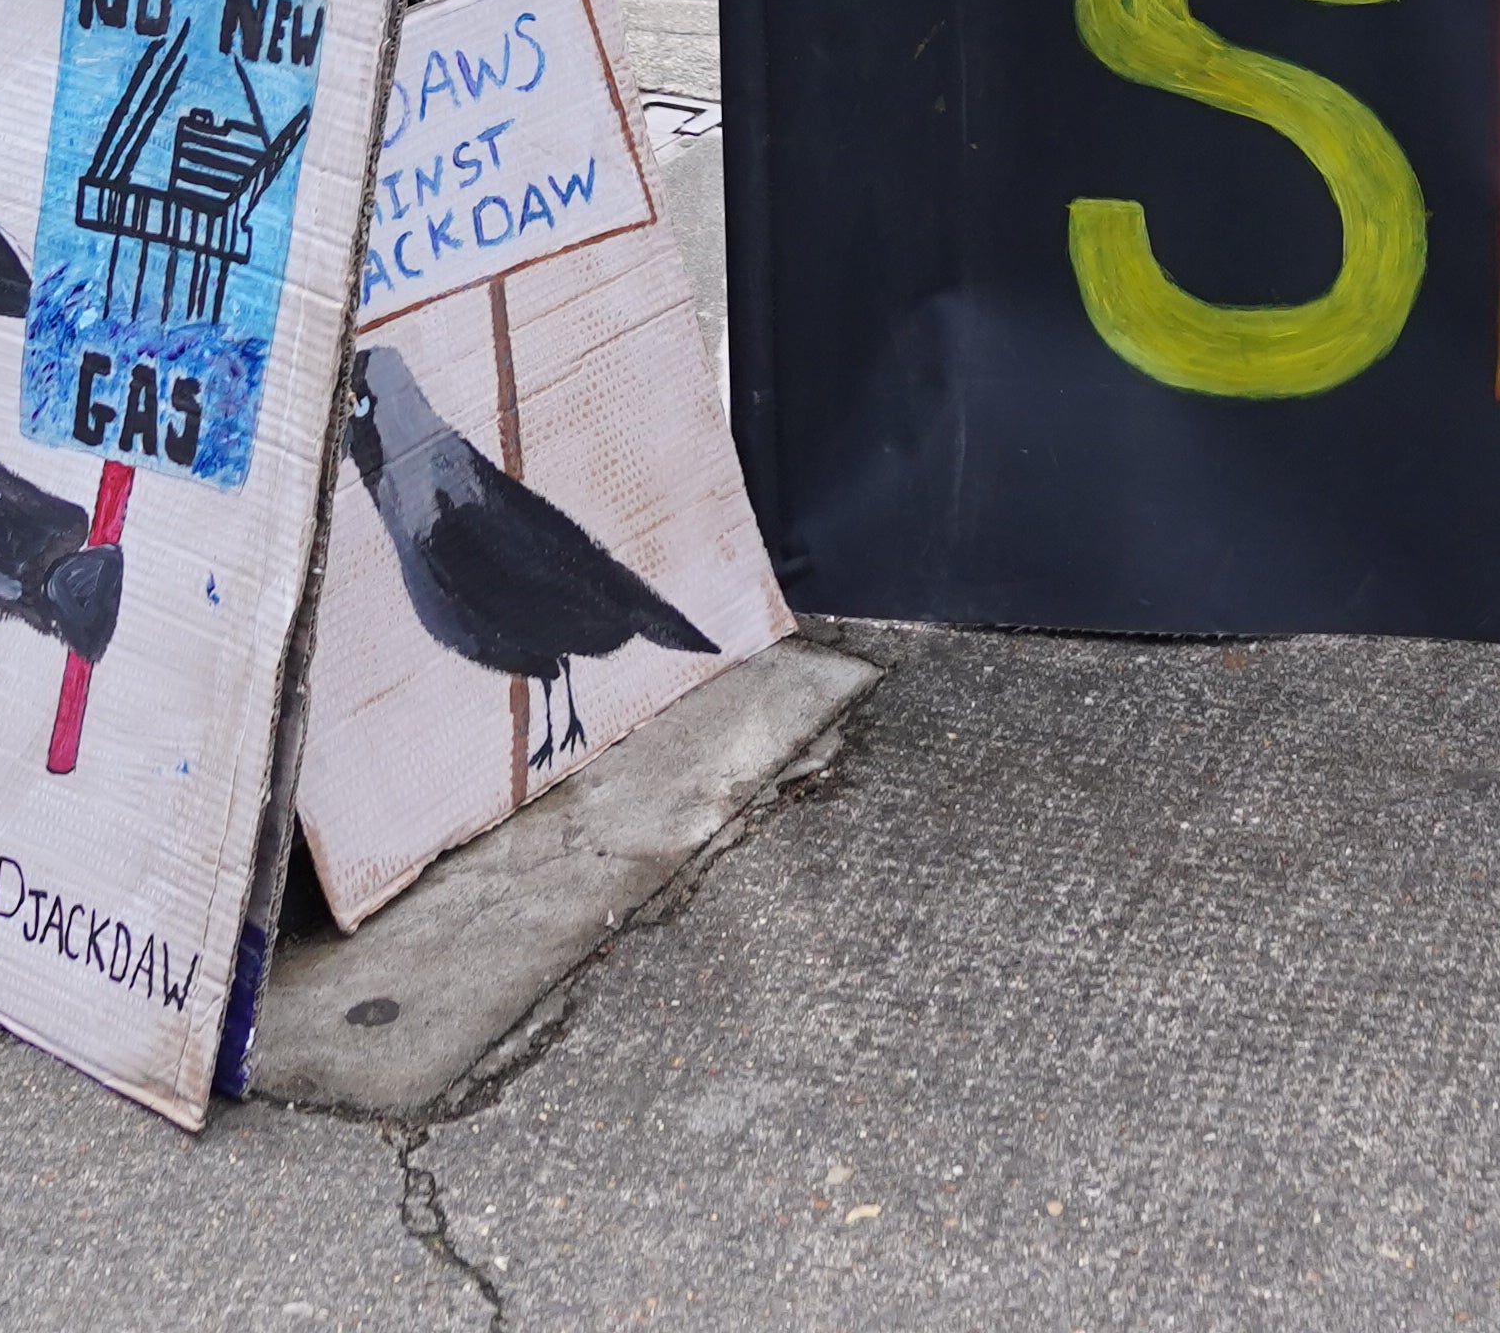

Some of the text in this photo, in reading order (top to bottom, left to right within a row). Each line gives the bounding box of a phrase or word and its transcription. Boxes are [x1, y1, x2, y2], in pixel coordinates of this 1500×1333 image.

[383, 12, 546, 149] DAWS
[362, 156, 596, 306] ACKDAW
[73, 351, 203, 466] GAS
